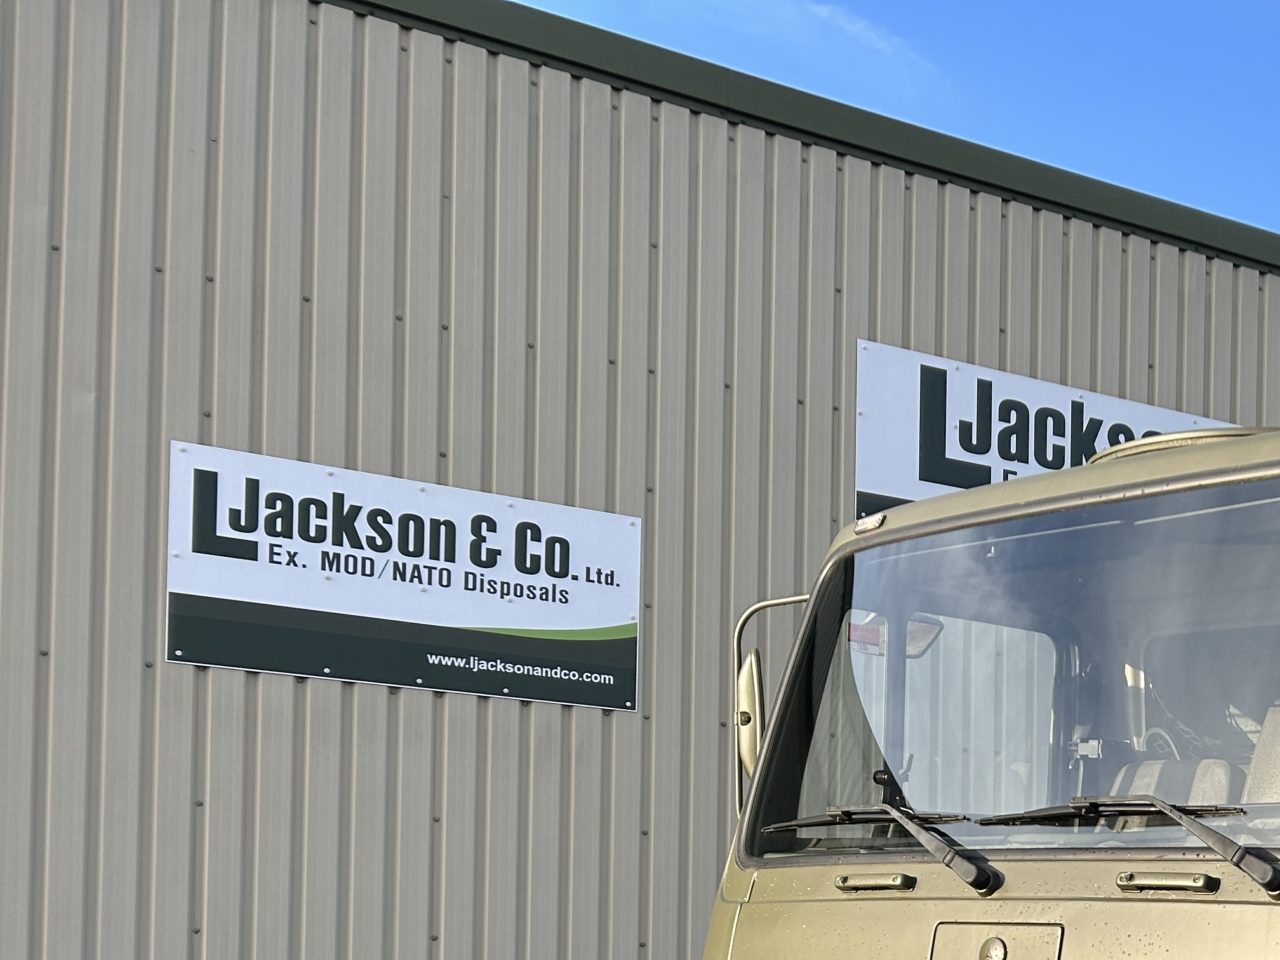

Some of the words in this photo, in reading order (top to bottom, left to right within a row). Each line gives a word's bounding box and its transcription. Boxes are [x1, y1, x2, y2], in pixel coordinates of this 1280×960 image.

[918, 363, 1164, 490] LJack
[268, 543, 307, 568] Ex.
[320, 549, 452, 588] MOD/NATO
[463, 570, 570, 605] Disposals
[469, 513, 502, 568] &
[514, 521, 579, 581] Co.
[585, 566, 621, 588] Ltd.
[426, 651, 614, 685] www.ljacksonandco.com
